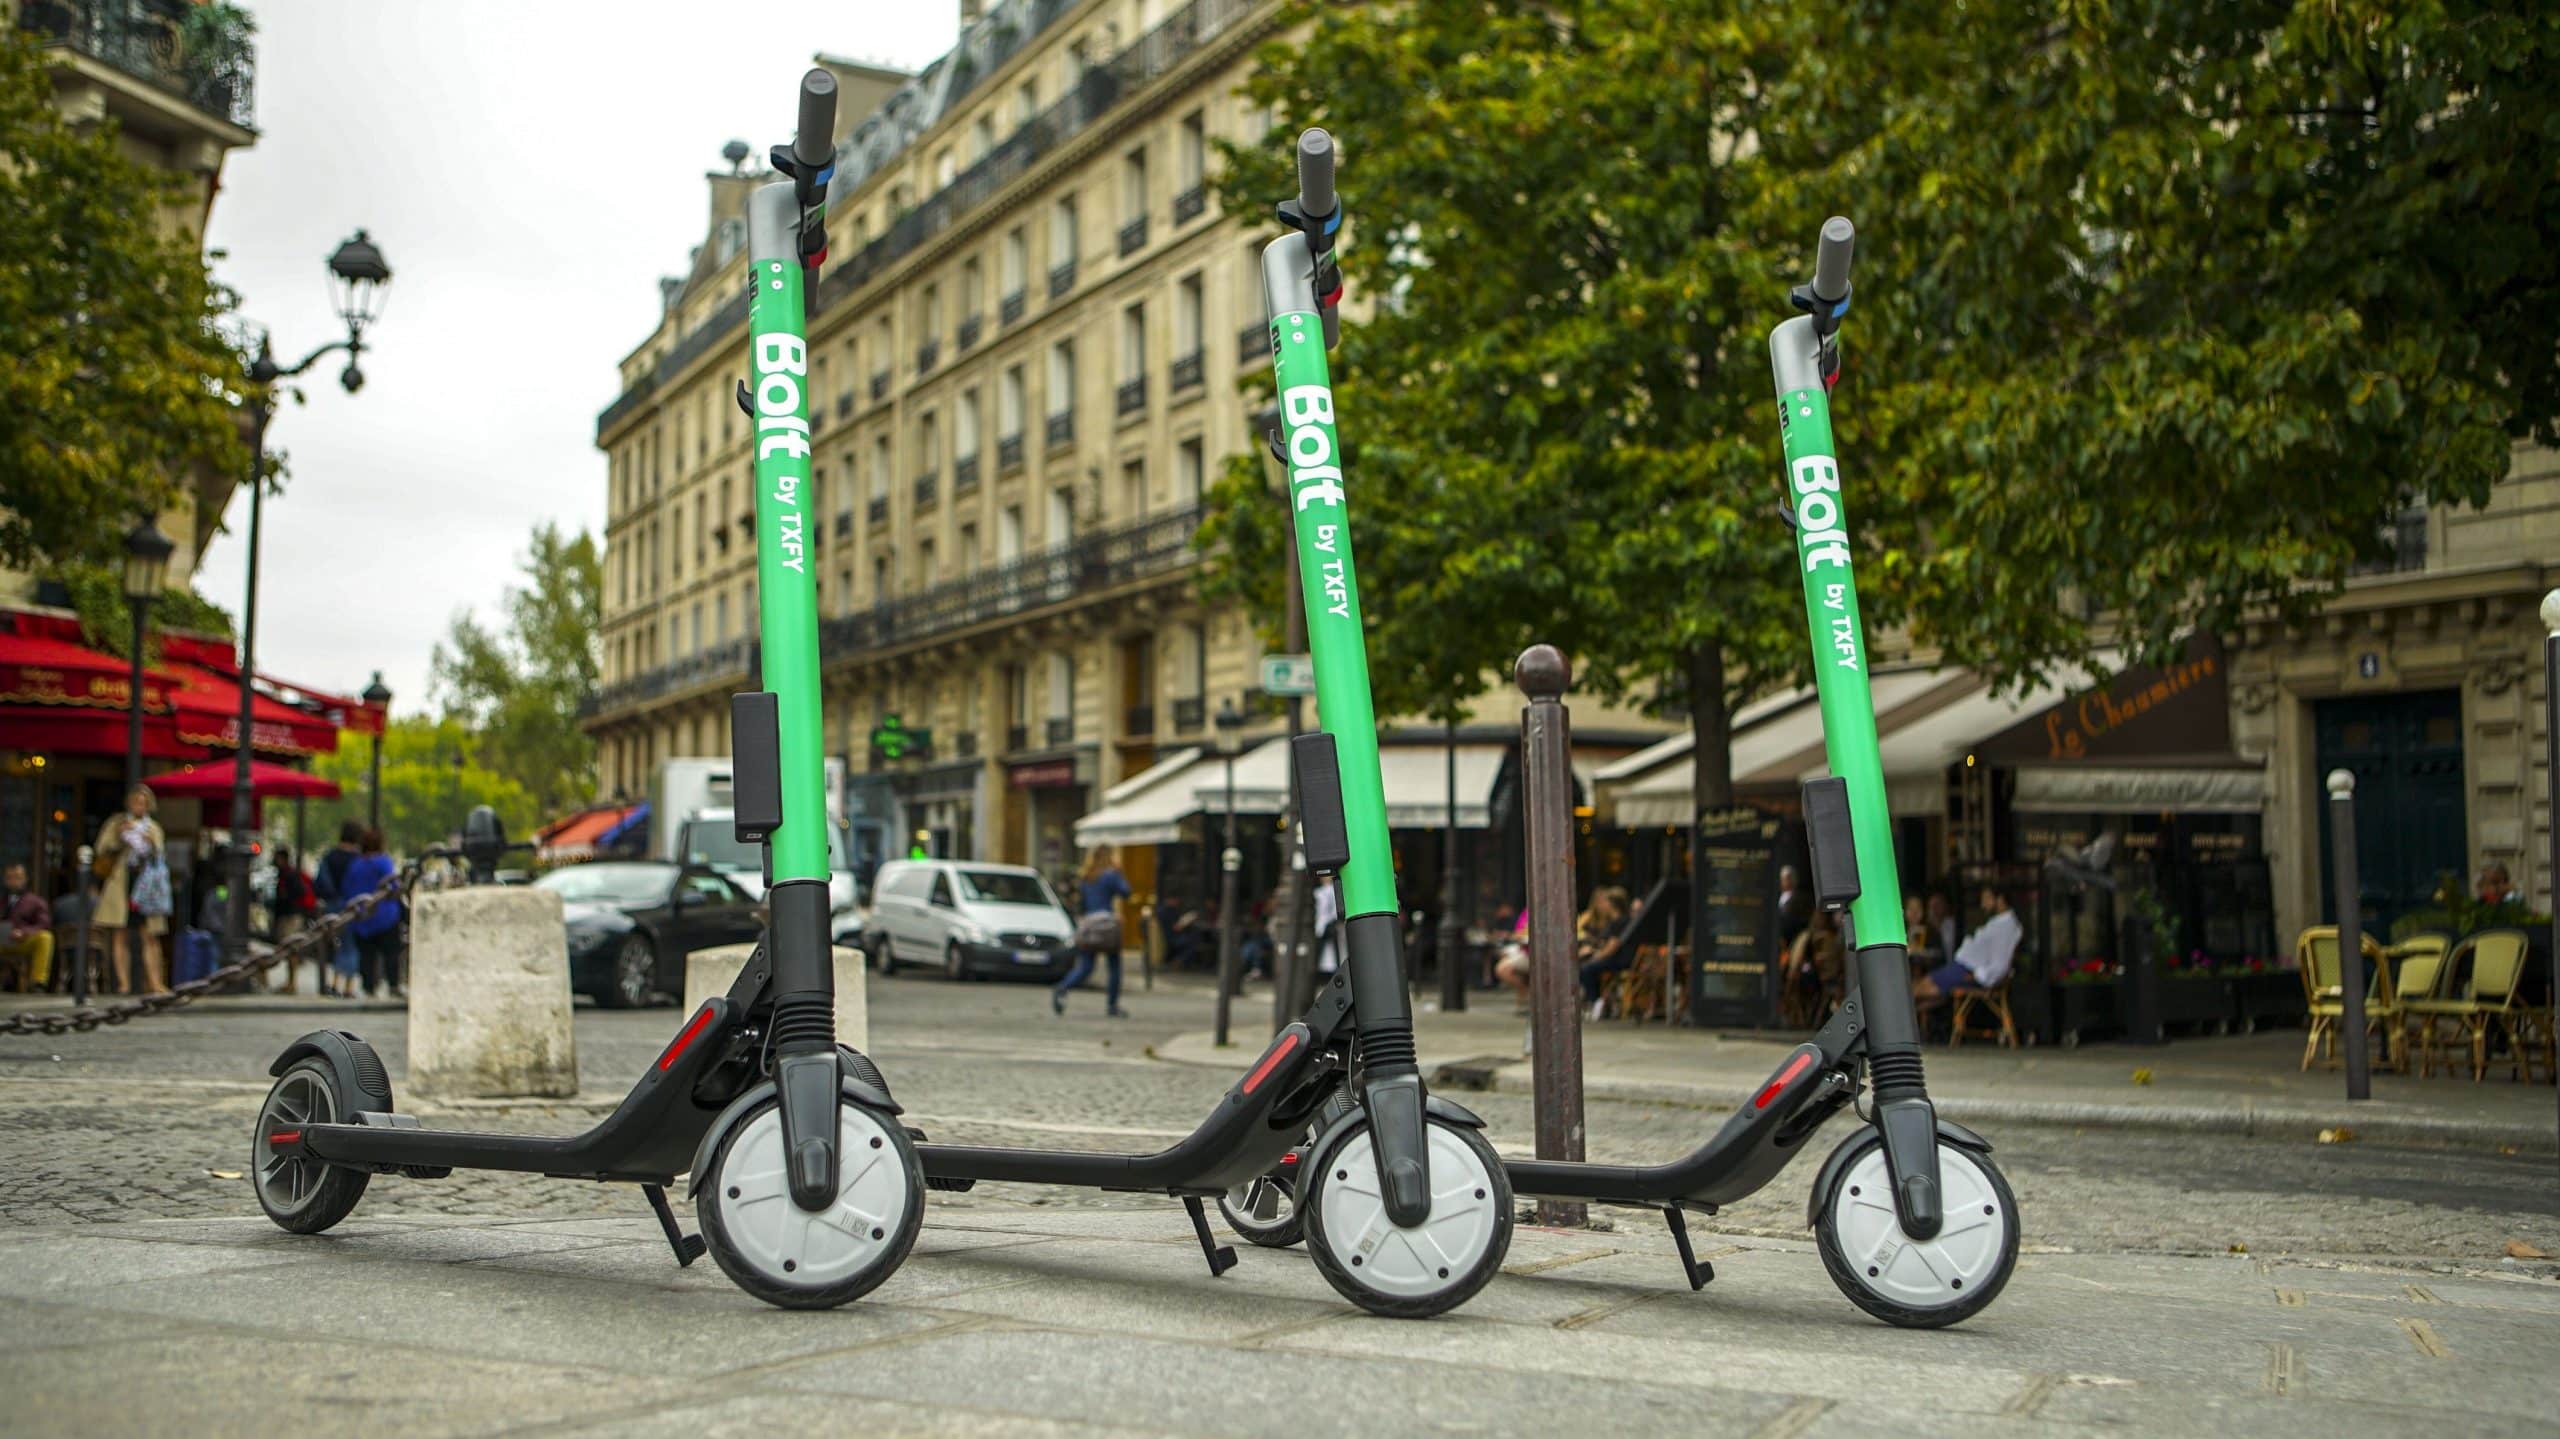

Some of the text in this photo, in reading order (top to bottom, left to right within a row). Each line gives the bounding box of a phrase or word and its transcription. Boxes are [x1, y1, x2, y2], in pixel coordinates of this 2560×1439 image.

[755, 332, 811, 574] Bolt by TXFY
[1283, 384, 1350, 618] Bolt by TXFY
[1791, 454, 1859, 671] Bolt by TXFY
